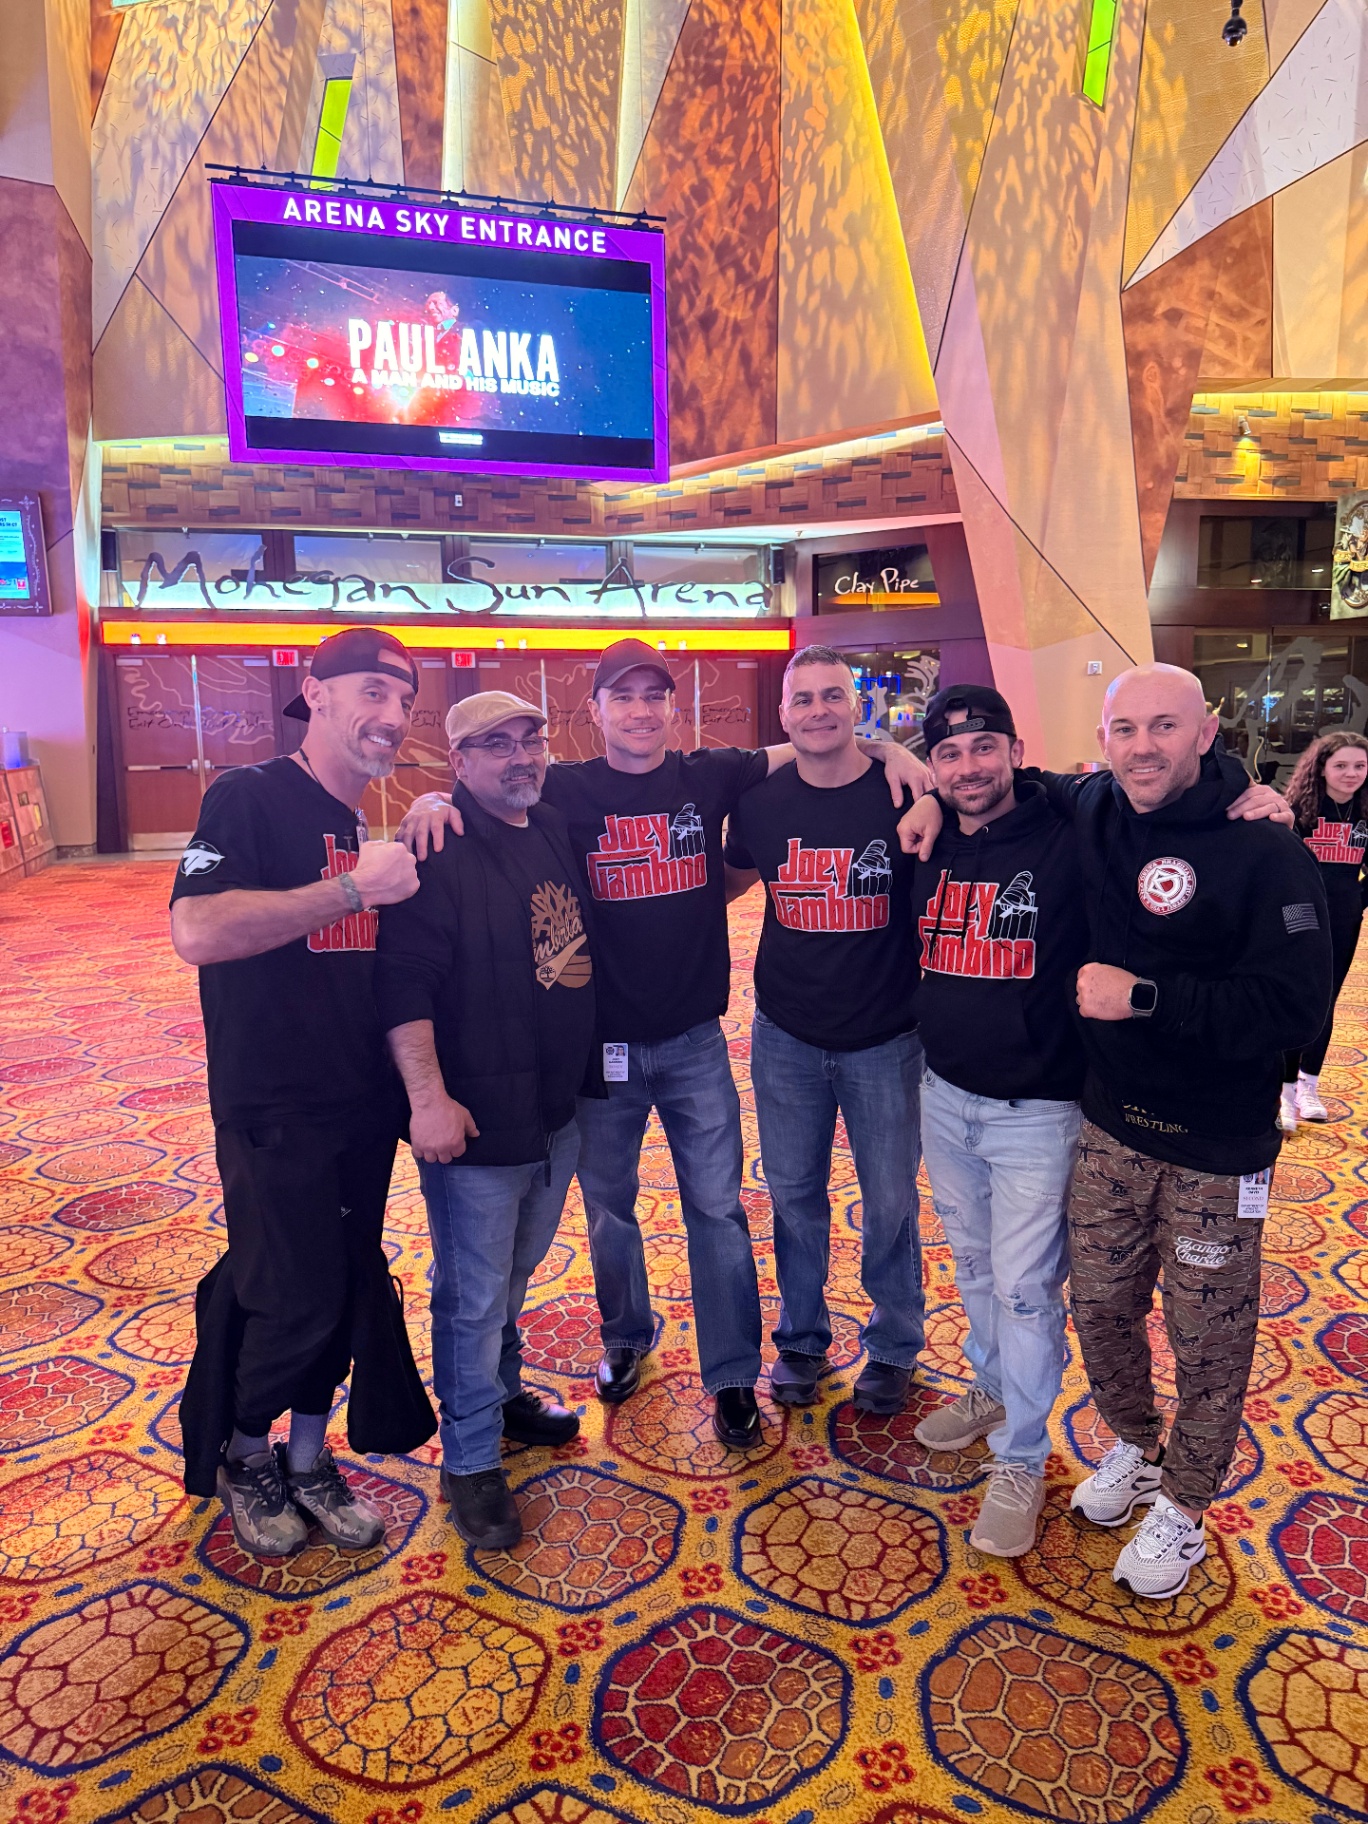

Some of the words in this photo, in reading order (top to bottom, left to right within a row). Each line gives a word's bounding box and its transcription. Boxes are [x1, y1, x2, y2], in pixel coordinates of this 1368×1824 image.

[283, 197, 385, 230] ARENA
[396, 210, 449, 236] SKY
[461, 216, 606, 254] ENTRANCE
[348, 318, 446, 374] PAUL
[458, 328, 560, 383] ANKA
[352, 368, 368, 384] A
[371, 369, 418, 388] MAN
[420, 372, 463, 391] AND
[465, 376, 498, 393] HIS
[501, 378, 560, 397] MUSIC
[134, 544, 431, 611] Mohegan
[446, 556, 572, 613] Sun
[586, 557, 773, 618] Arena
[834, 571, 875, 595] Clay
[880, 567, 919, 594] Pipe
[597, 813, 670, 861] Joey
[1312, 816, 1353, 847] Joey
[586, 848, 708, 902] Gambino
[778, 838, 855, 899] Joey
[768, 881, 890, 933] Gambino
[926, 869, 1000, 939] Joey
